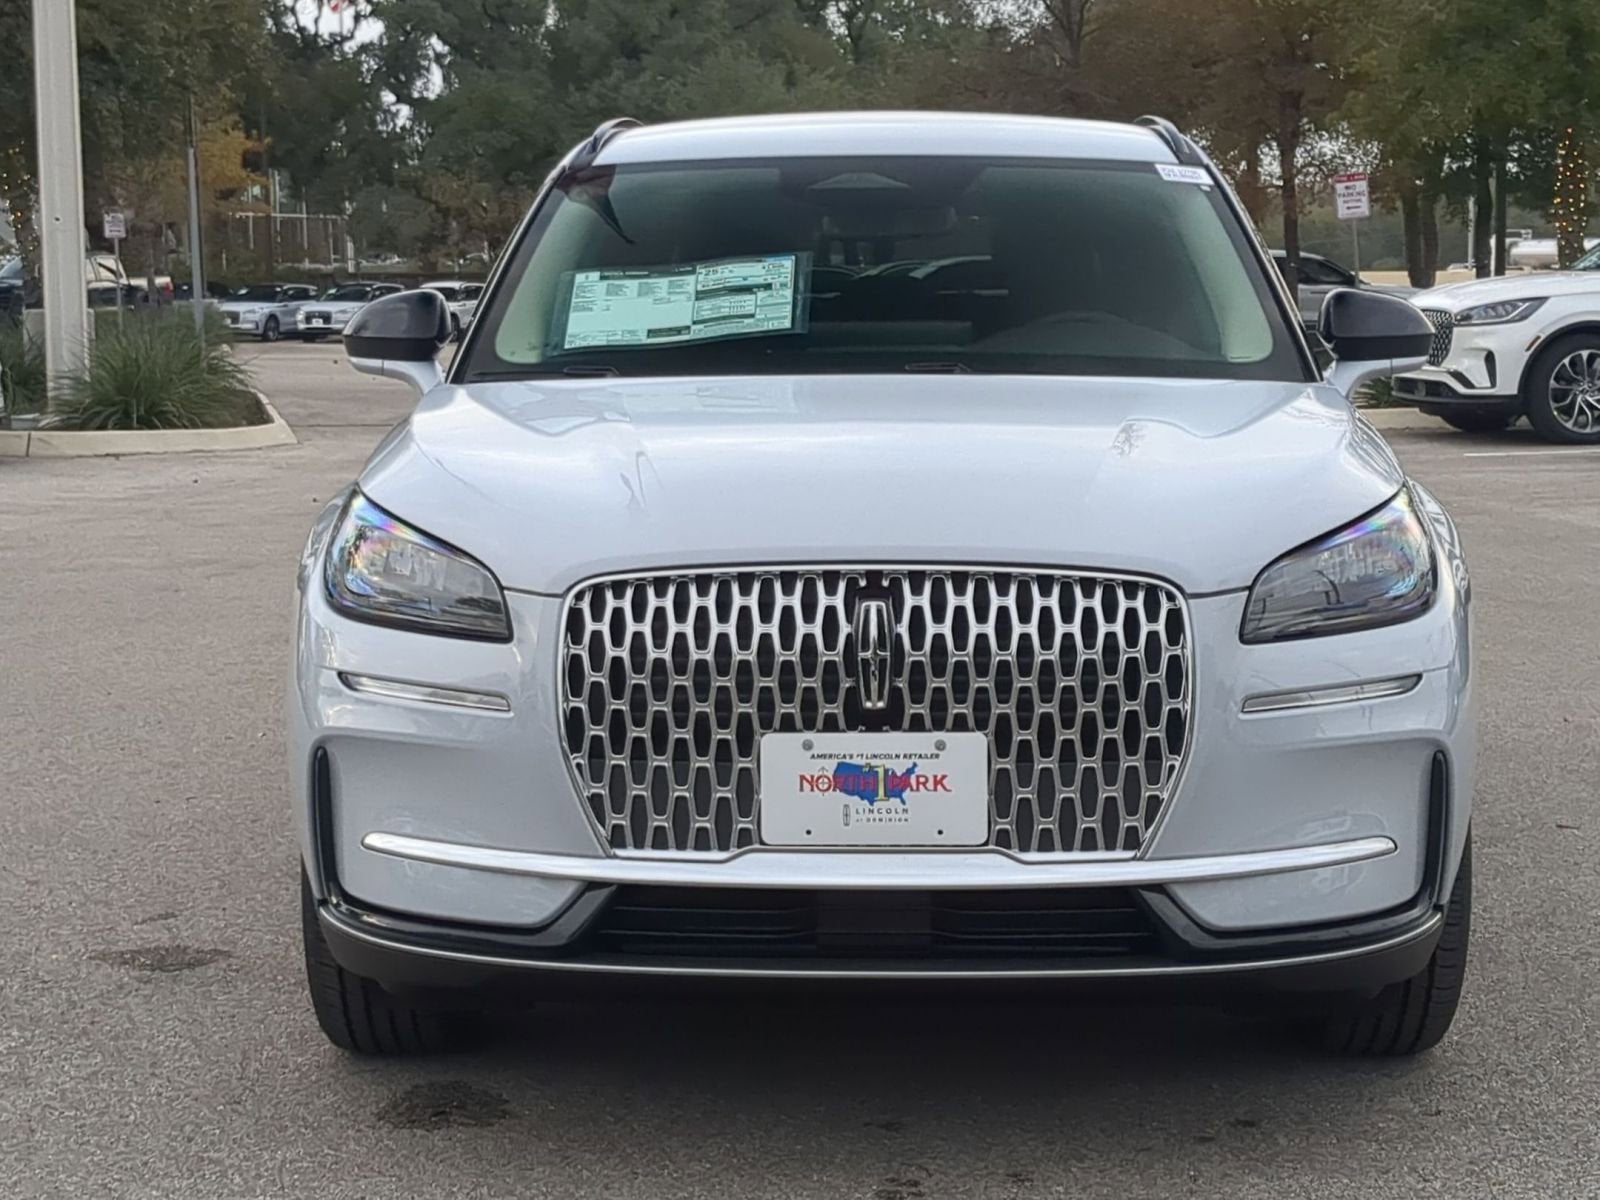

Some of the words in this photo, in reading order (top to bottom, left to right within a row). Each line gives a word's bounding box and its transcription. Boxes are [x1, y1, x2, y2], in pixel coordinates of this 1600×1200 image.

[799, 774, 877, 793] NORTH
[888, 774, 952, 793] PARK
[855, 807, 909, 815] LINCOLN
